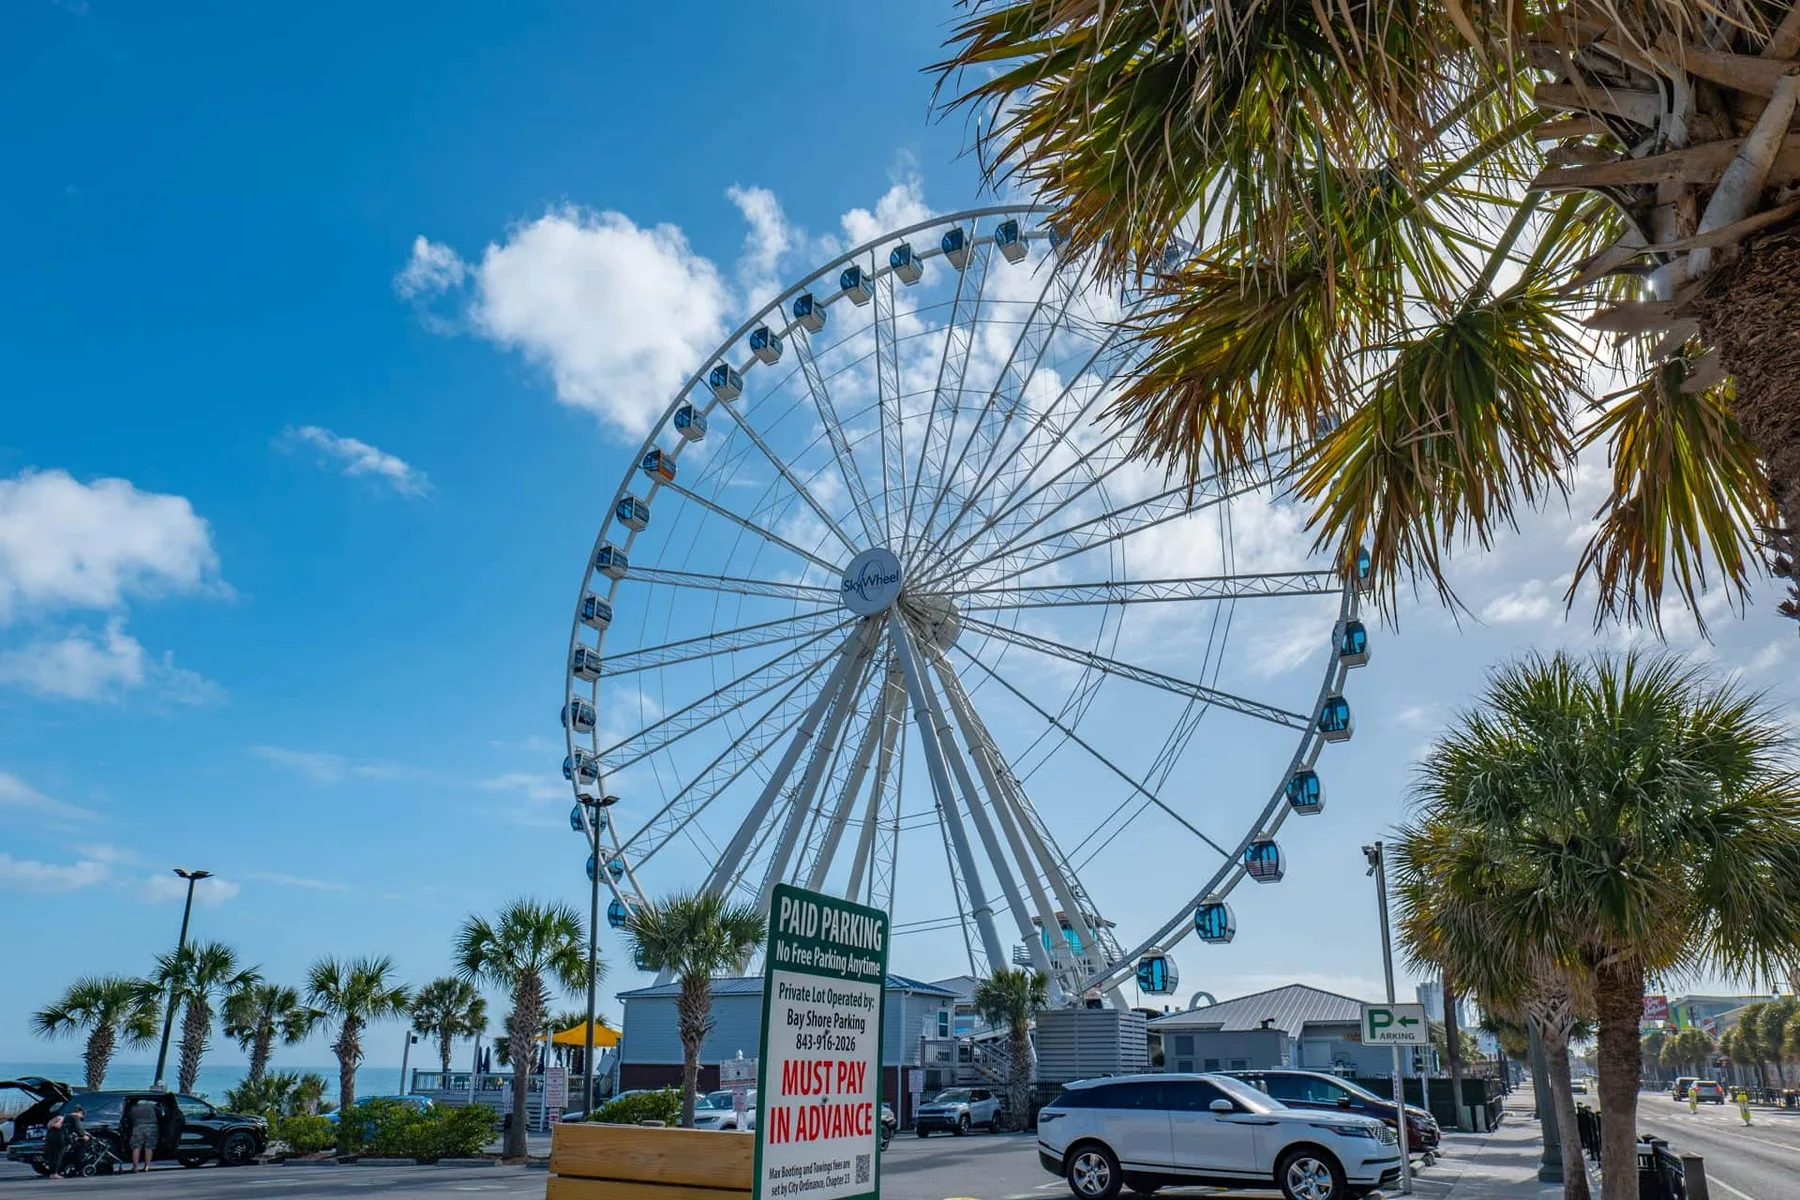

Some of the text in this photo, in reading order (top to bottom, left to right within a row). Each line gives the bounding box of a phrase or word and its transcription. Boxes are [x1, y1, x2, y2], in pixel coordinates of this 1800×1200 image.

[843, 569, 899, 594] SkyWheel
[779, 896, 883, 951] PAID PARKING
[776, 940, 880, 978] No Free Parking Anytime
[779, 982, 875, 1012] Private Lot Operated by:
[787, 1008, 866, 1034] Bay Shore Parking
[796, 1033, 856, 1051] 843-916-2026
[781, 1059, 833, 1096] MUST
[837, 1060, 867, 1095] PAY
[769, 1102, 873, 1145] IN ADVANCE
[769, 1167, 780, 1179] Max
[781, 1165, 802, 1178] Booting
[803, 1162, 813, 1175] and
[833, 1159, 842, 1171] fees
[771, 1184, 780, 1196] set
[781, 1182, 787, 1197] by
[788, 1181, 798, 1195] City
[826, 1175, 844, 1189] Chapter
